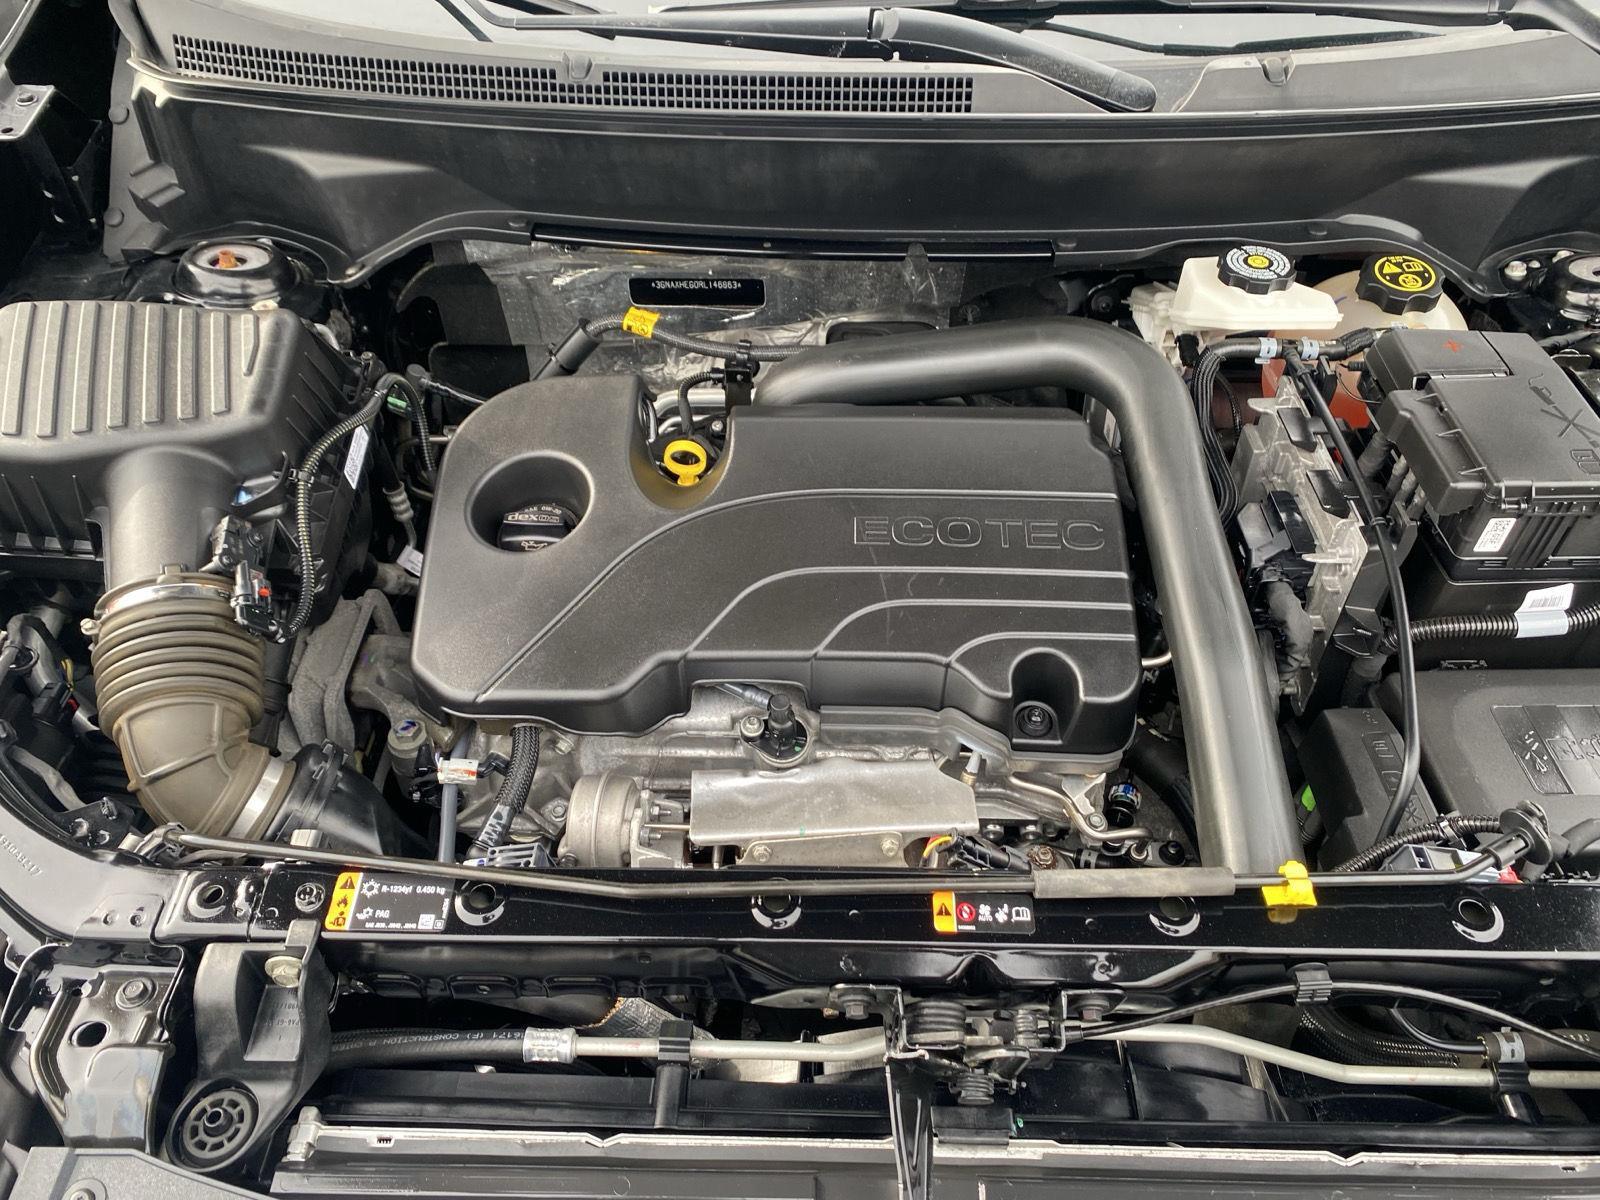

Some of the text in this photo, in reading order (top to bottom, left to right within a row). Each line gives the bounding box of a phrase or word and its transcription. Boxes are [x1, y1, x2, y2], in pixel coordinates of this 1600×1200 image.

[853, 515, 1106, 551] ECOTEC
[416, 885, 435, 894] 0.450
[436, 886, 445, 895] kg
[383, 1032, 460, 1045] CONSTRUCTION
